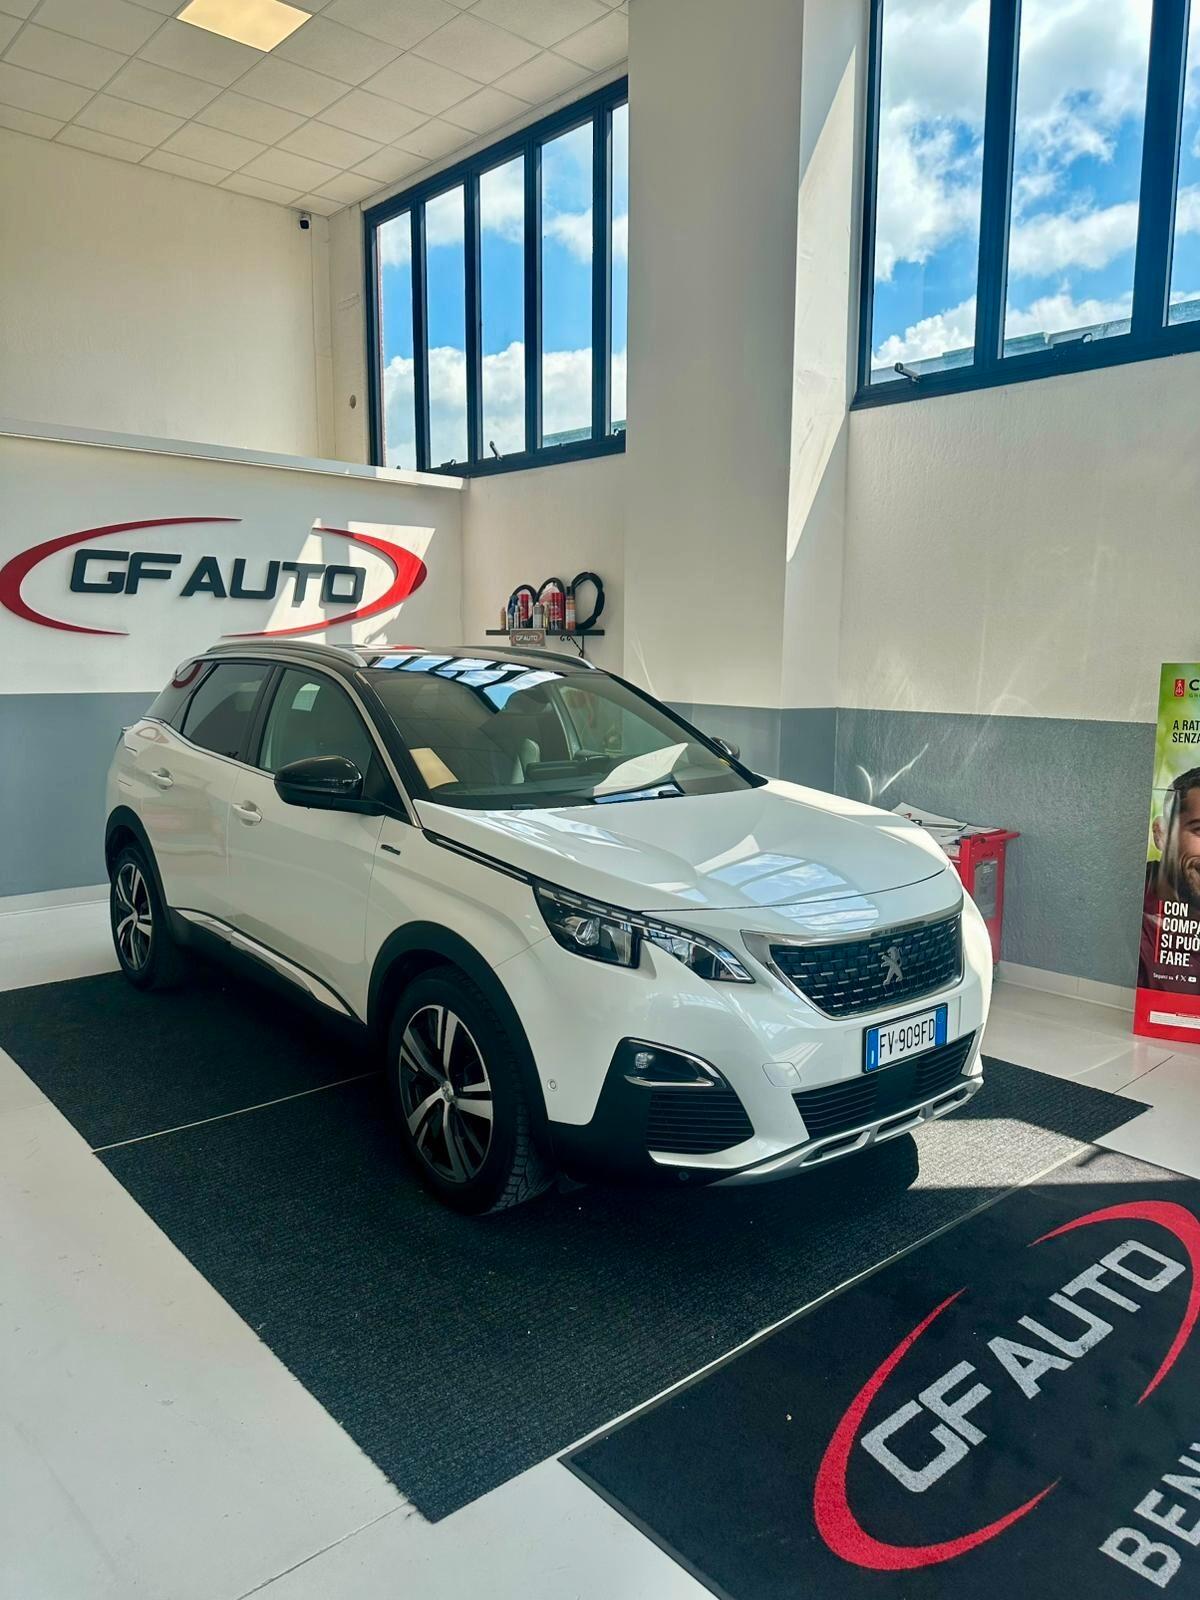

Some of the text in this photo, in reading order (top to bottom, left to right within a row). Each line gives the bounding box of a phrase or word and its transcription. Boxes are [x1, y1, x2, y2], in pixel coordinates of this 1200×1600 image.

[70, 548, 366, 605] GF AUTO
[1172, 720, 1179, 730] A
[1164, 901, 1188, 917] CON
[1161, 933, 1200, 951] SI PUÒ
[860, 1239, 1186, 1493] GF AUTO
